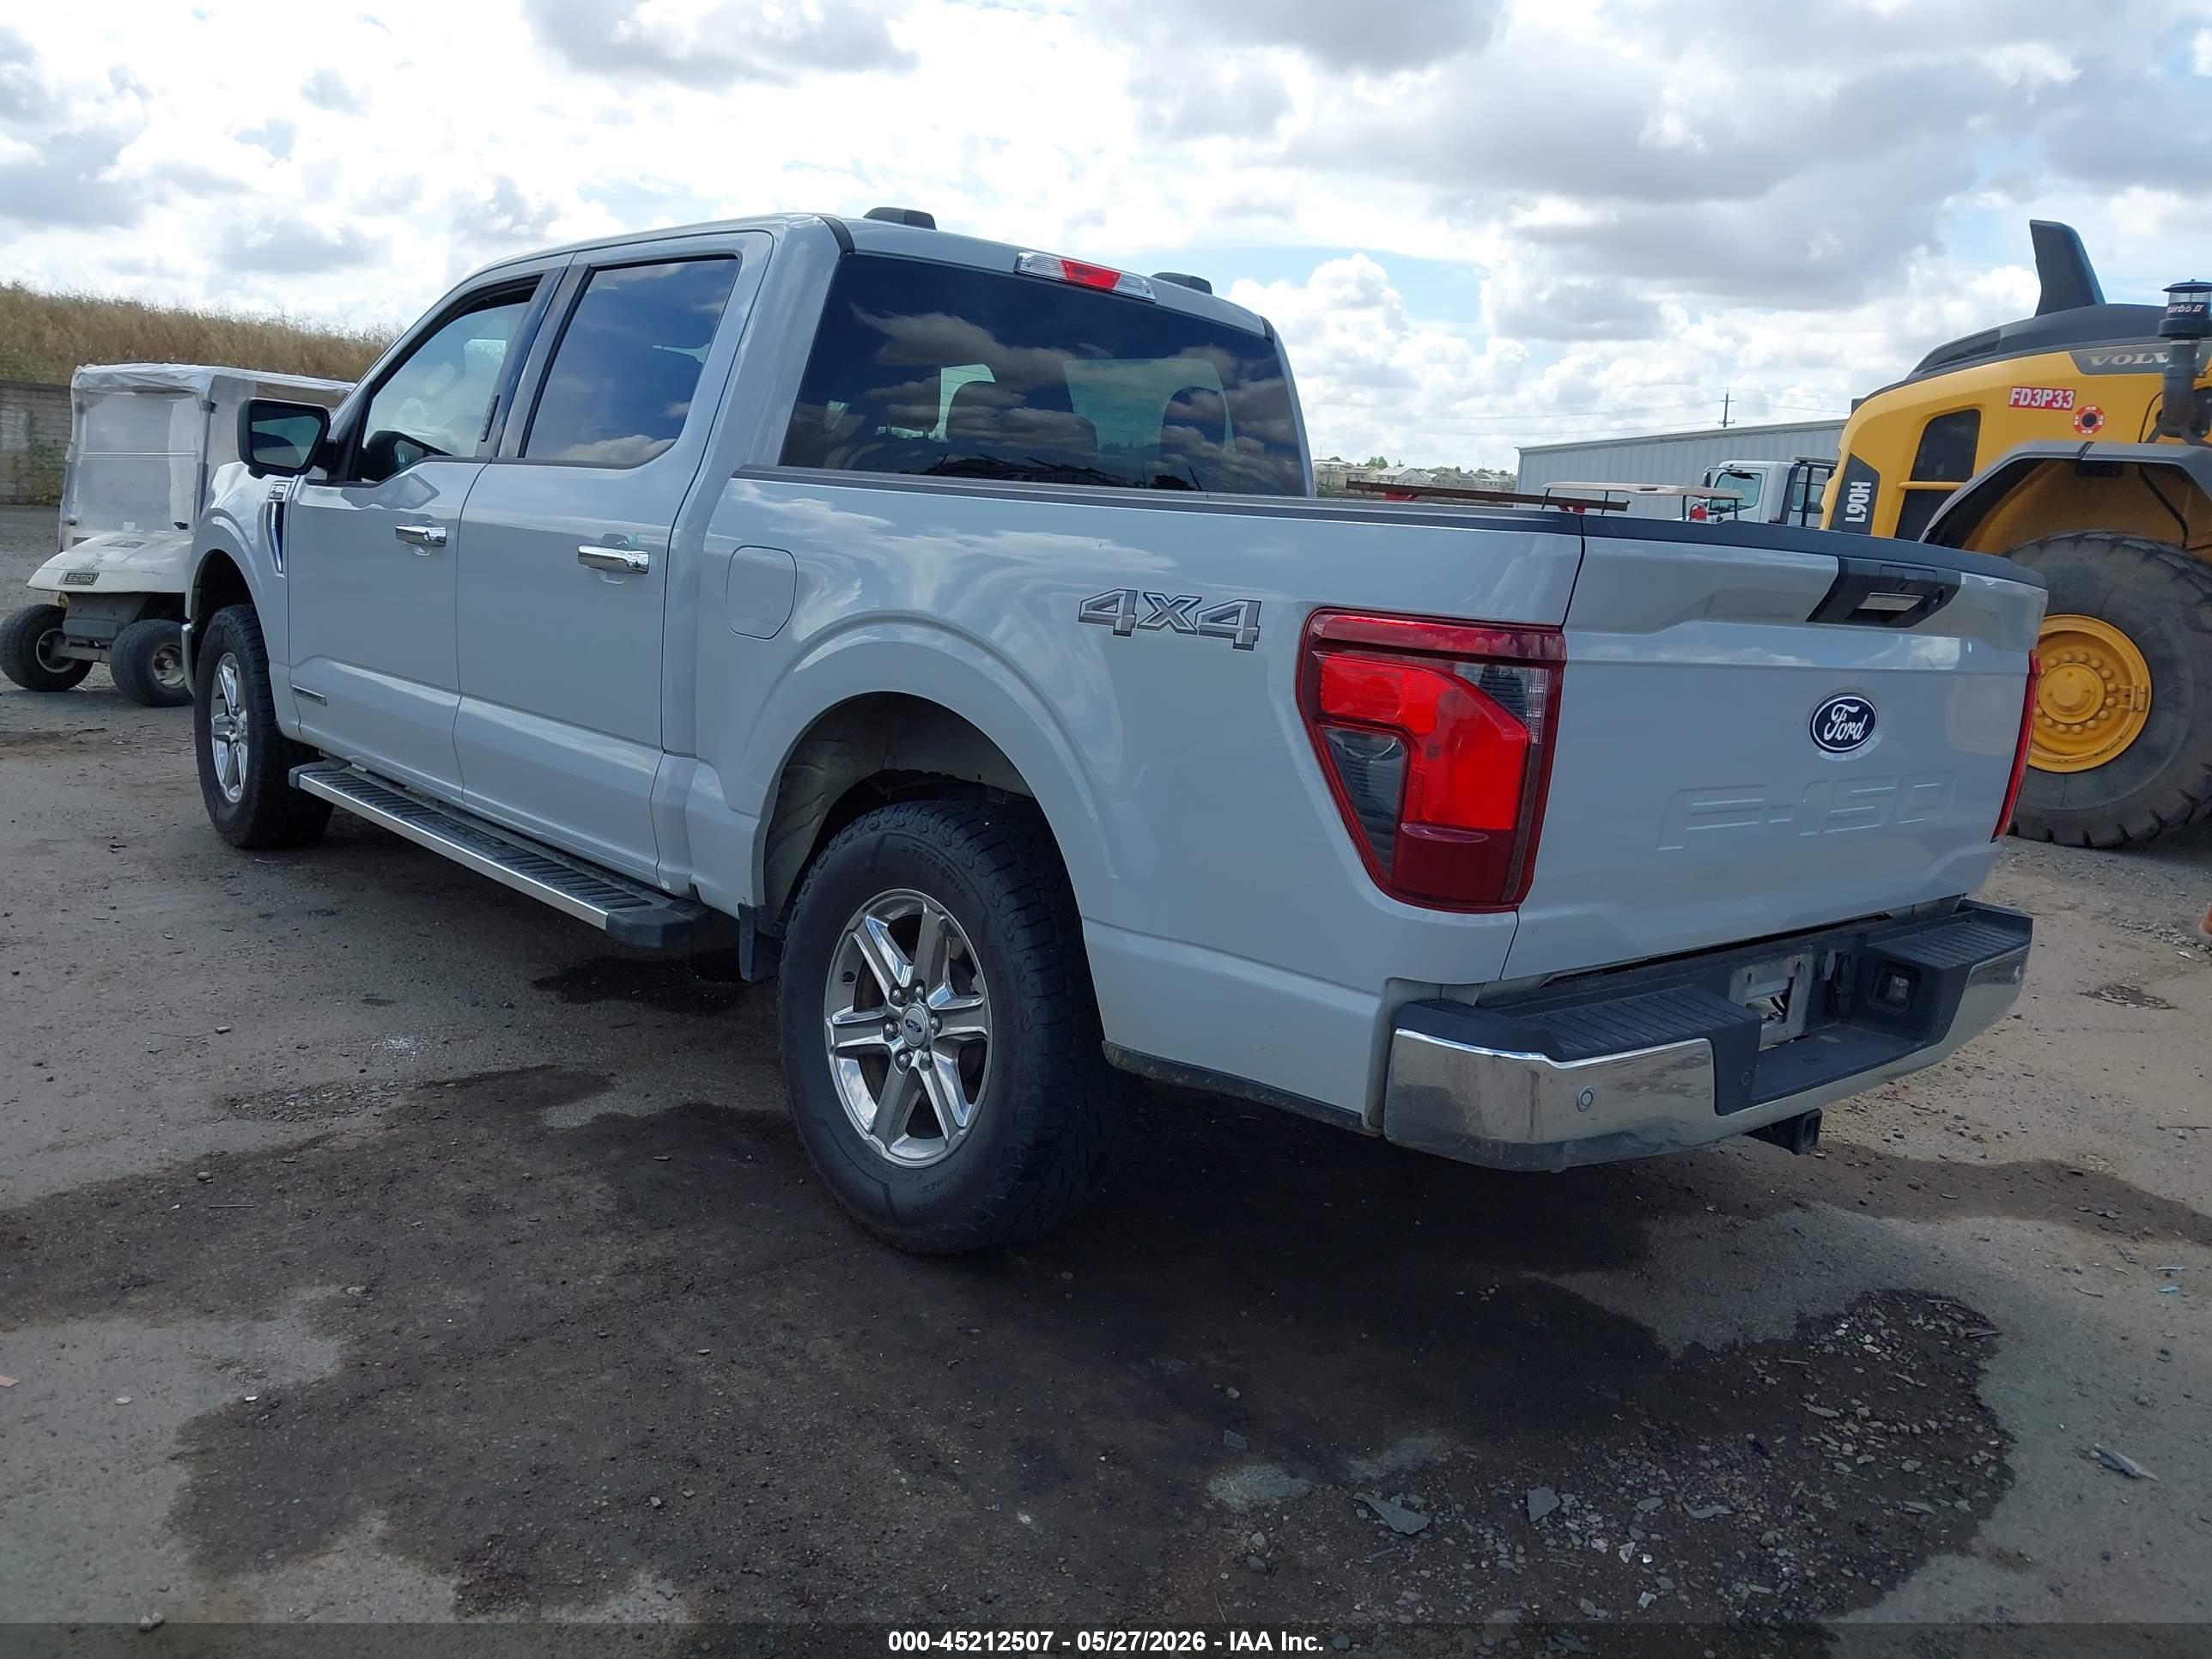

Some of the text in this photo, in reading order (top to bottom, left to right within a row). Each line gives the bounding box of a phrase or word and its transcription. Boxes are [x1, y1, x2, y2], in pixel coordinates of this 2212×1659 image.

[2087, 351, 2200, 367] VOLV
[2009, 387, 2075, 409] FD3P33
[1844, 481, 1872, 523] L90H
[1823, 703, 1869, 741] Ford
[1656, 769, 1959, 851] F-150
